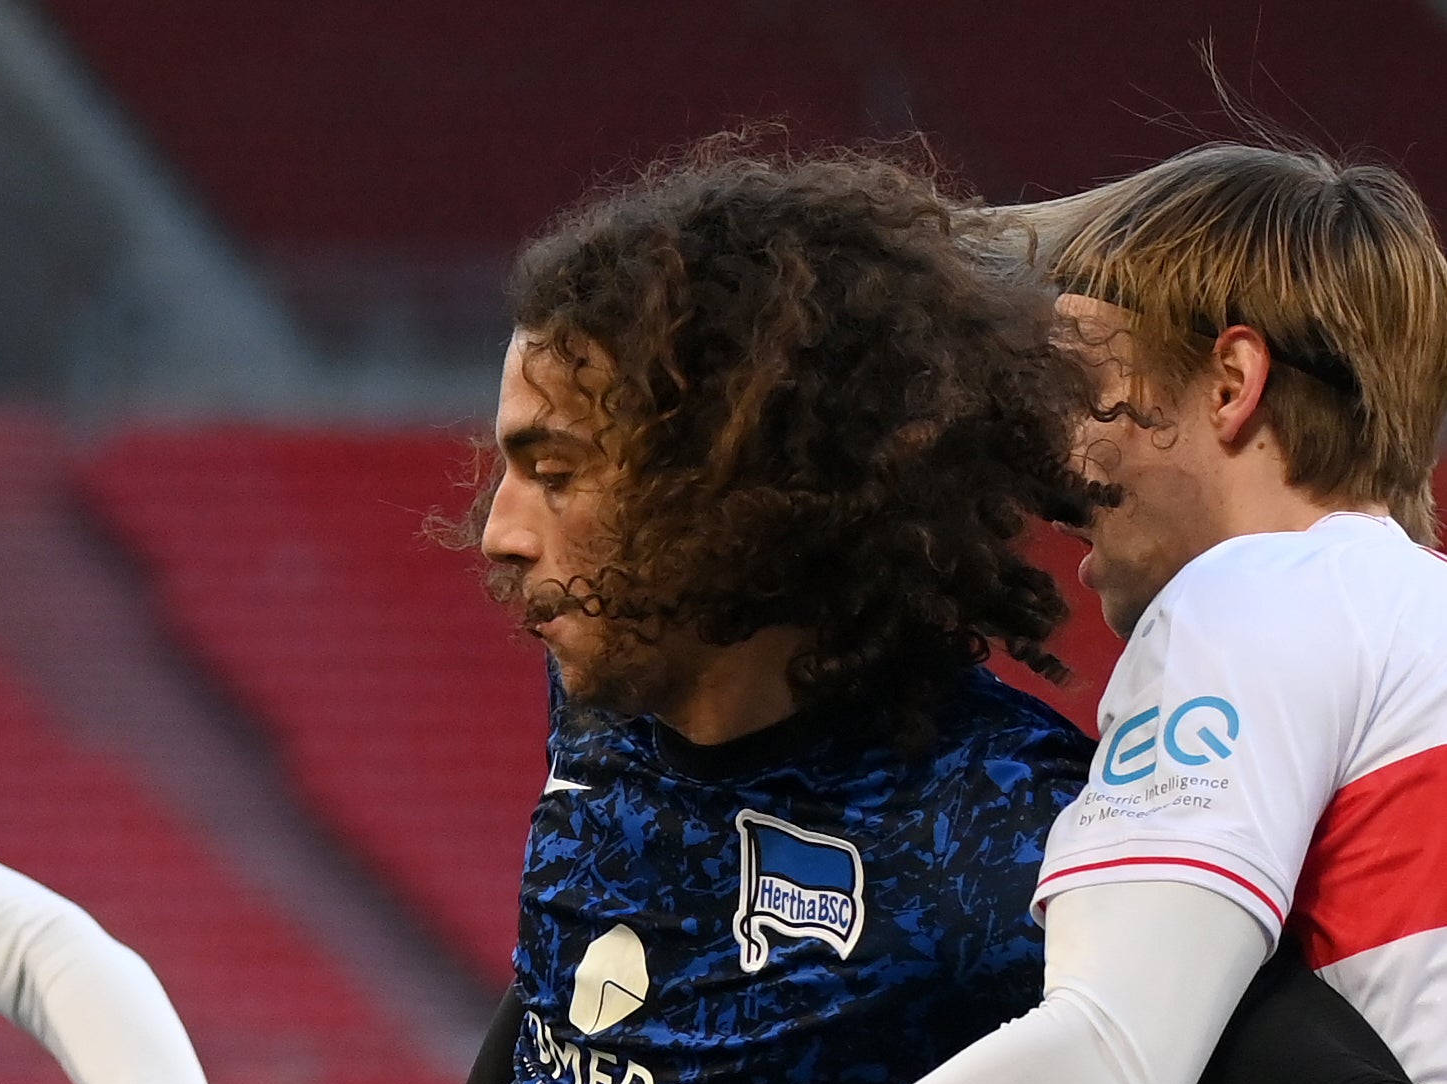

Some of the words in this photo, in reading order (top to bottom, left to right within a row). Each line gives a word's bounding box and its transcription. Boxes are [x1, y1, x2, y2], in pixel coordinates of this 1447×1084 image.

[1102, 695, 1240, 786] EQ
[1145, 775, 1229, 801] Intelligence
[1079, 814, 1096, 827] by
